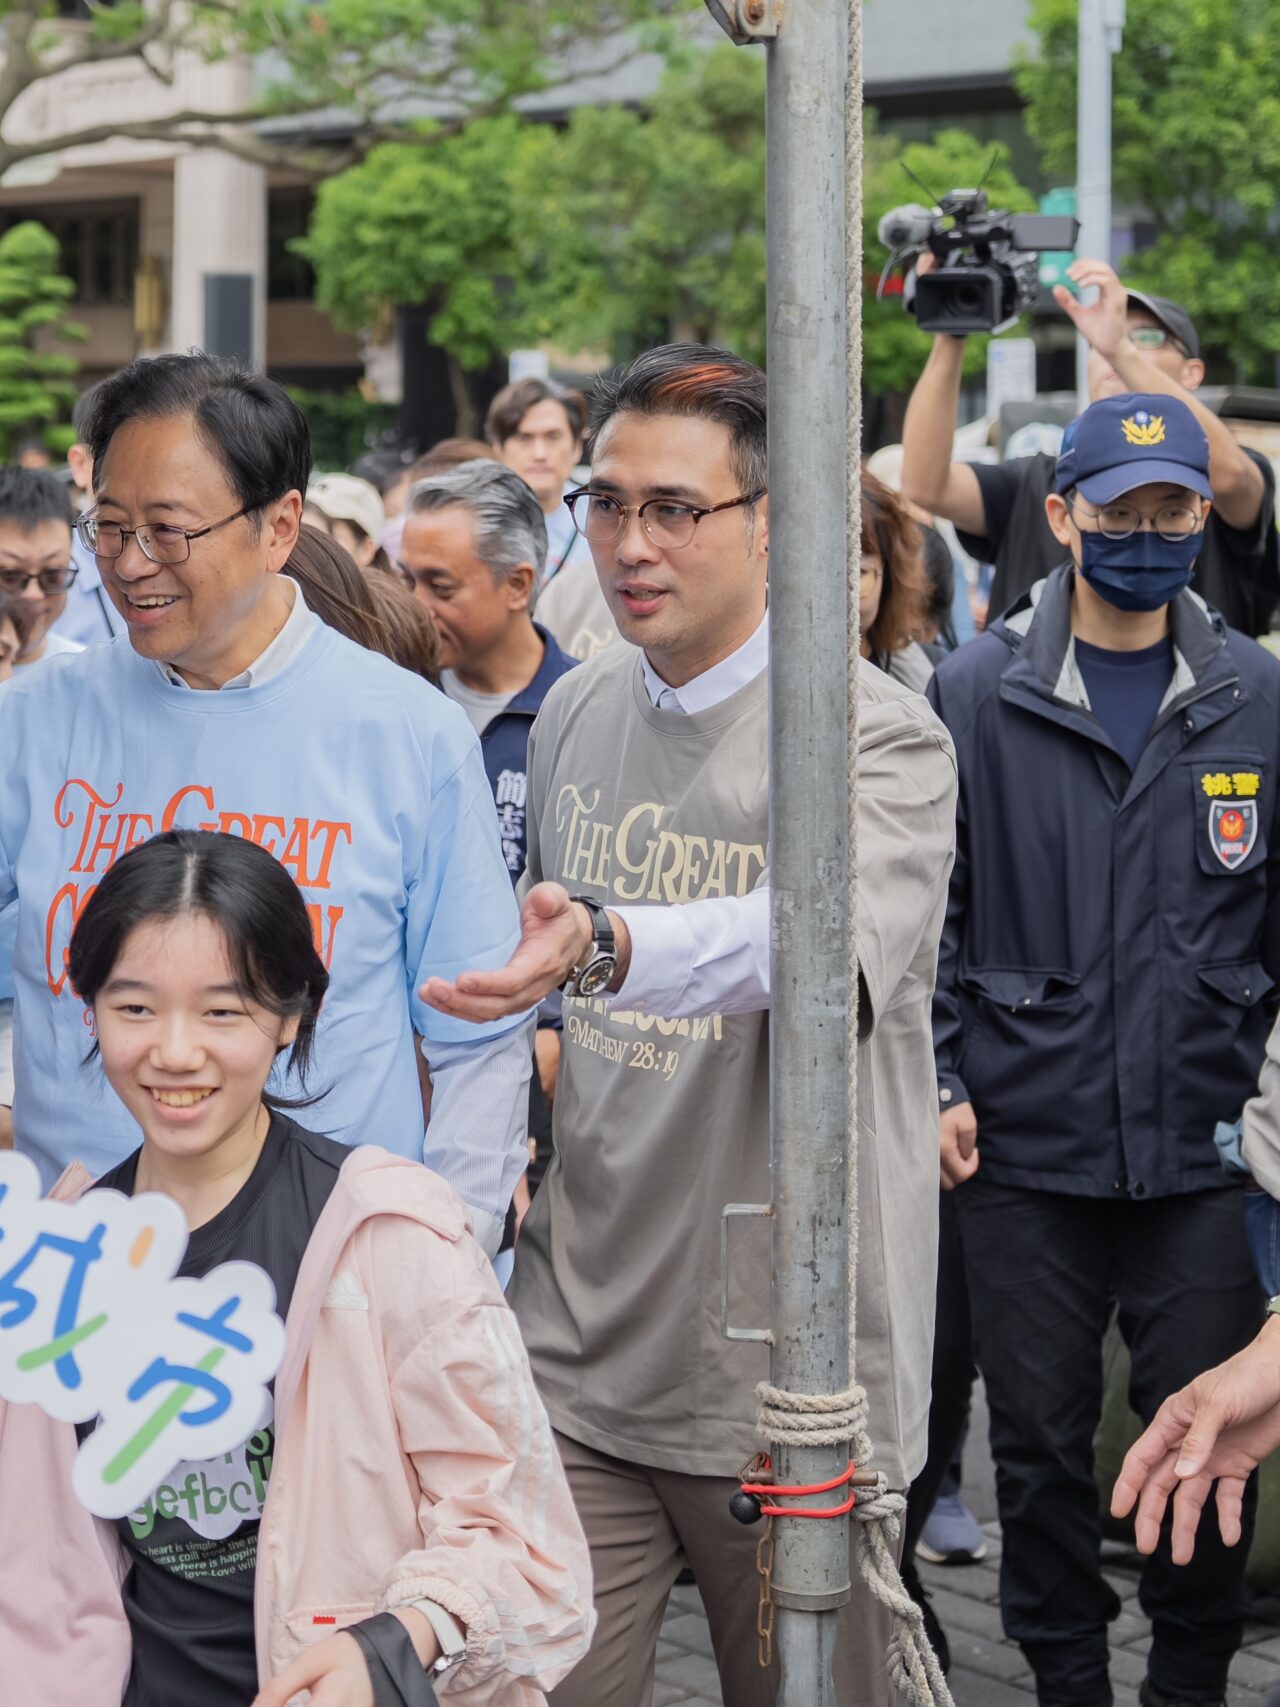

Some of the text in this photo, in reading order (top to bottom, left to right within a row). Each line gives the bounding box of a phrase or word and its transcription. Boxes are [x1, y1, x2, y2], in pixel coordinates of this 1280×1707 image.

[556, 784, 765, 903] THE GREAT
[632, 1041, 679, 1081] 28:19
